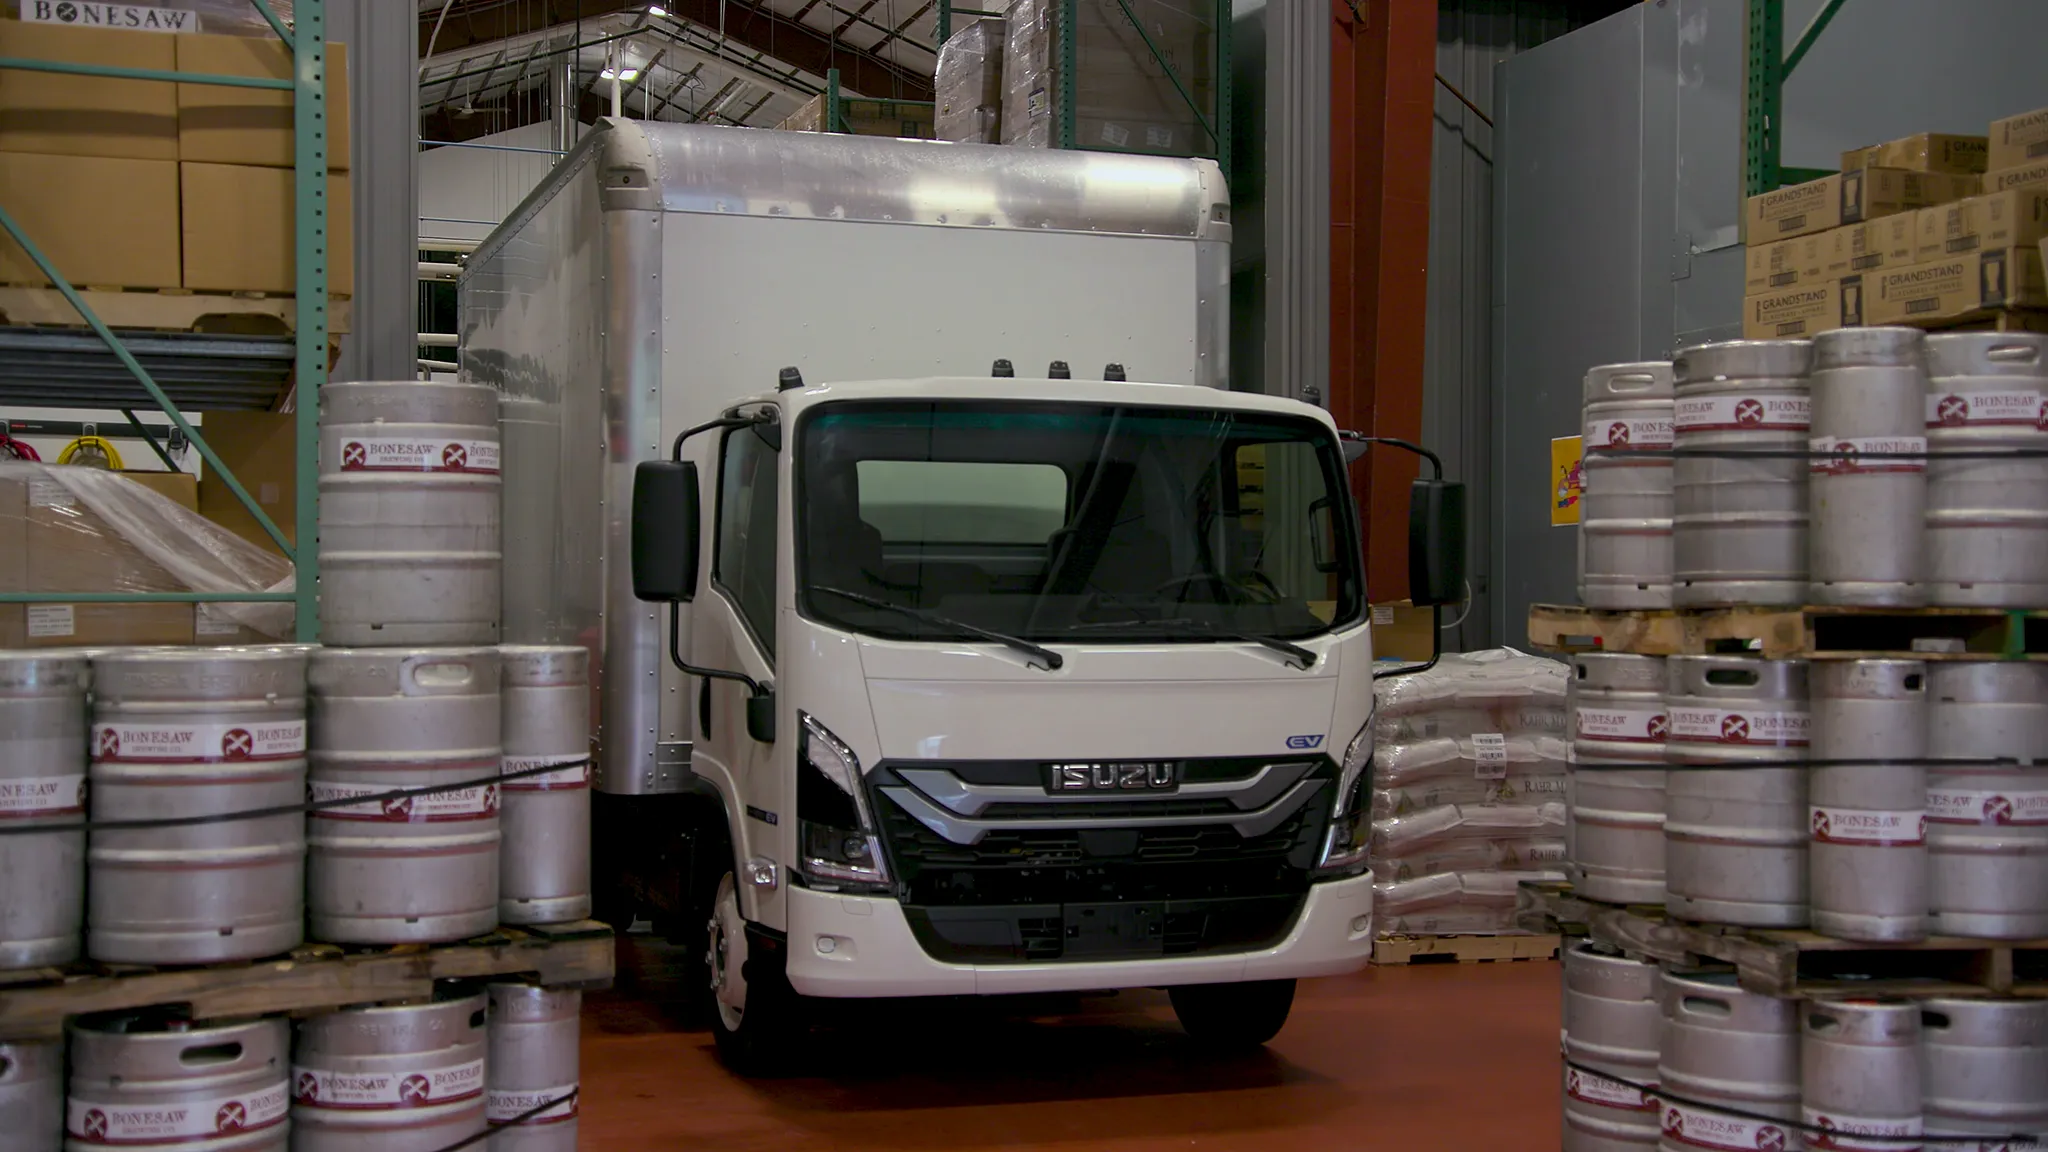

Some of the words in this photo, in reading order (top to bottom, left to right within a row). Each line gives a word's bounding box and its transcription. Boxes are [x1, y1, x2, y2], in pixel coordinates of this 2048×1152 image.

[2007, 167, 2048, 185] GRAND
[1766, 182, 1827, 206] GRANDSTAND
[1889, 263, 1964, 286] GRANDSTAND
[1762, 289, 1827, 310] GRANDSTAND
[1972, 396, 2037, 407] BONESAW
[370, 443, 434, 455] BONESAW
[122, 731, 194, 744] BONESAW
[1288, 735, 1322, 748] EV
[1052, 763, 1173, 790] ISUZU
[1833, 814, 1901, 828] BONESAW
[321, 1077, 389, 1090] BONESAW
[112, 1110, 189, 1125] BONESAW
